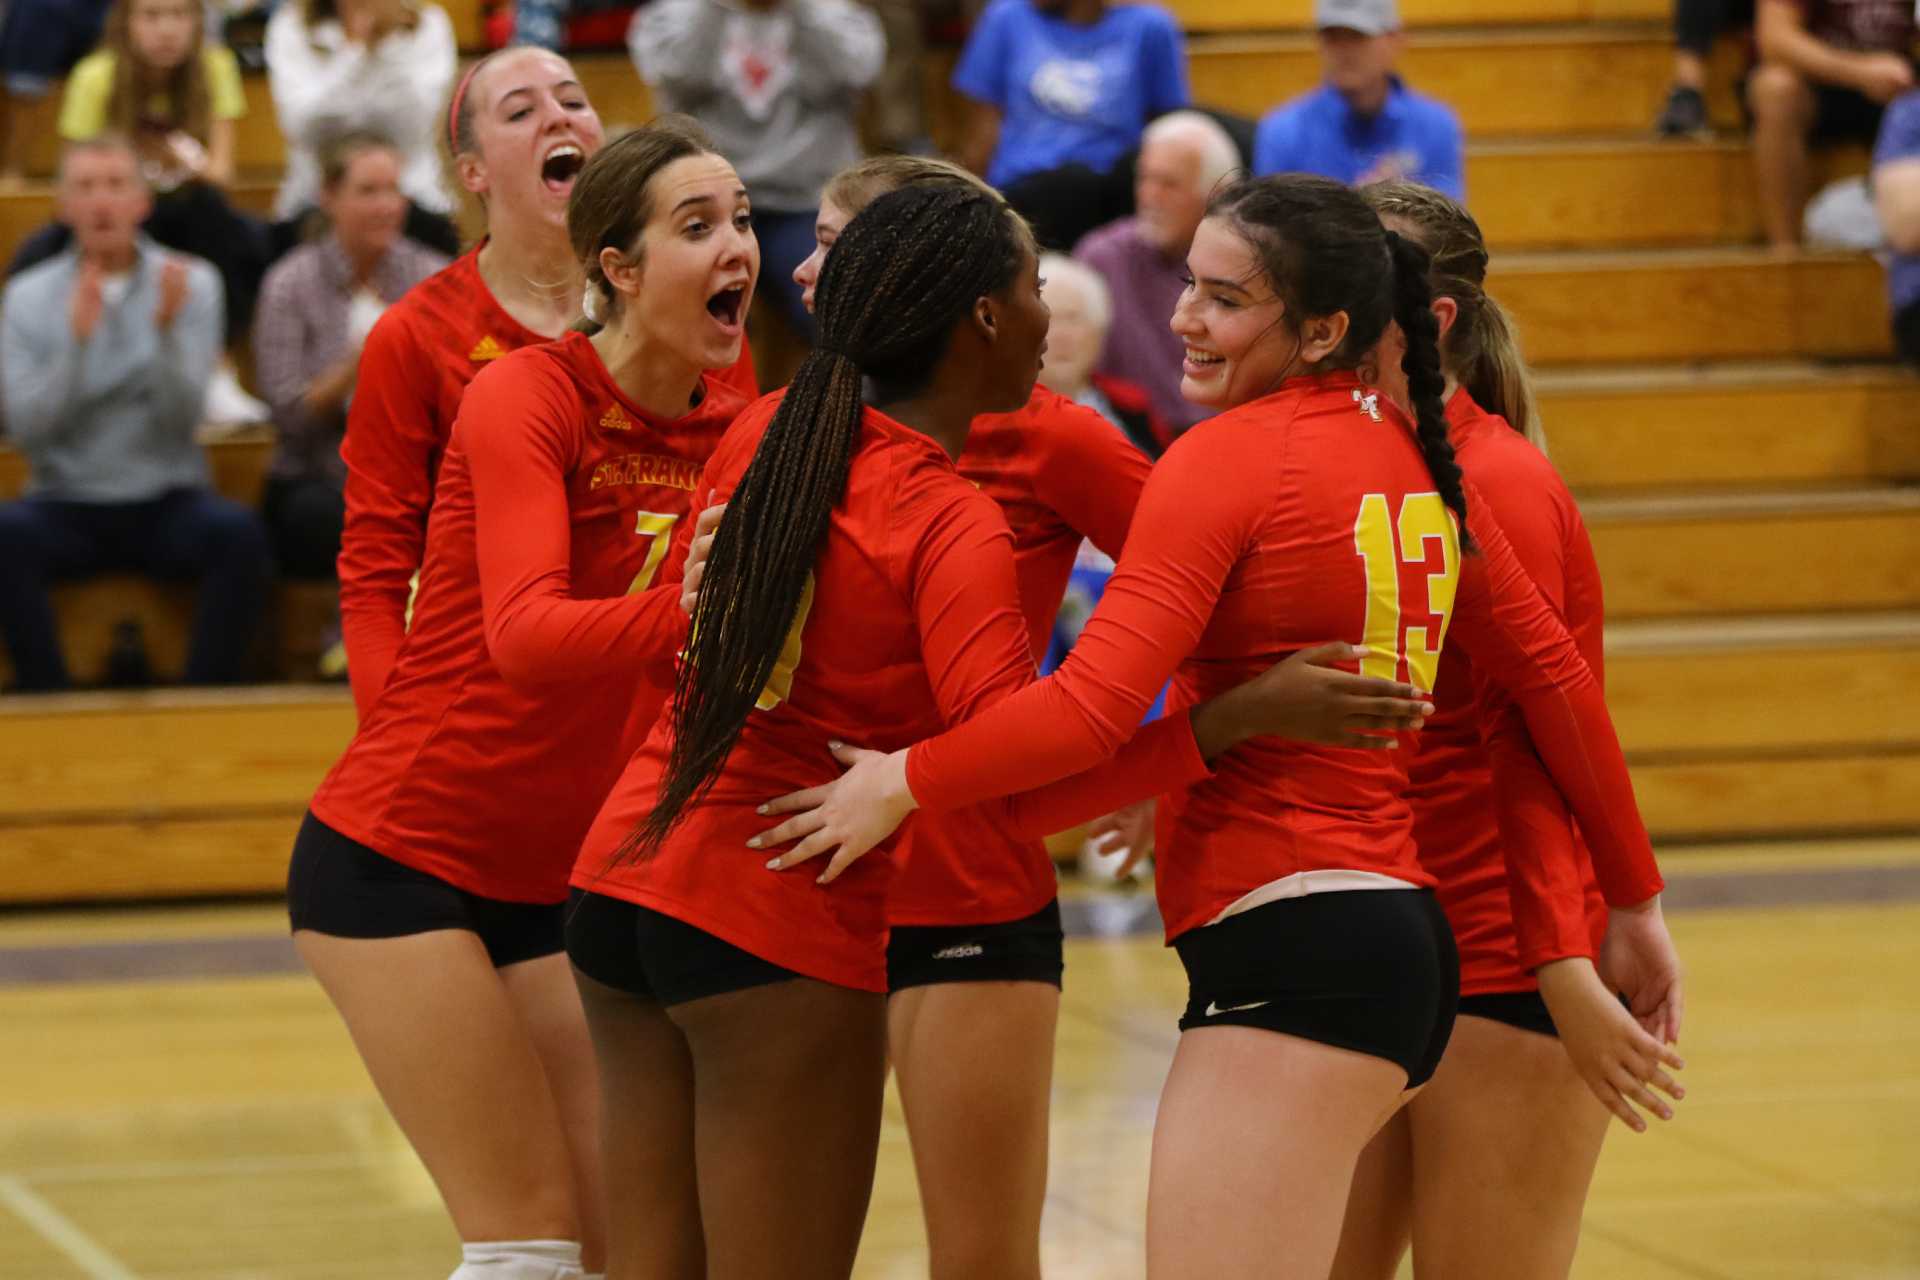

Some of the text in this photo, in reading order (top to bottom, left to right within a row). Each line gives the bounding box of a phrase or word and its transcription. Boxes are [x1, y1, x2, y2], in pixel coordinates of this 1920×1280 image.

[600, 418, 632, 431] adidas
[626, 510, 679, 597] 7
[1354, 492, 1461, 695] 13
